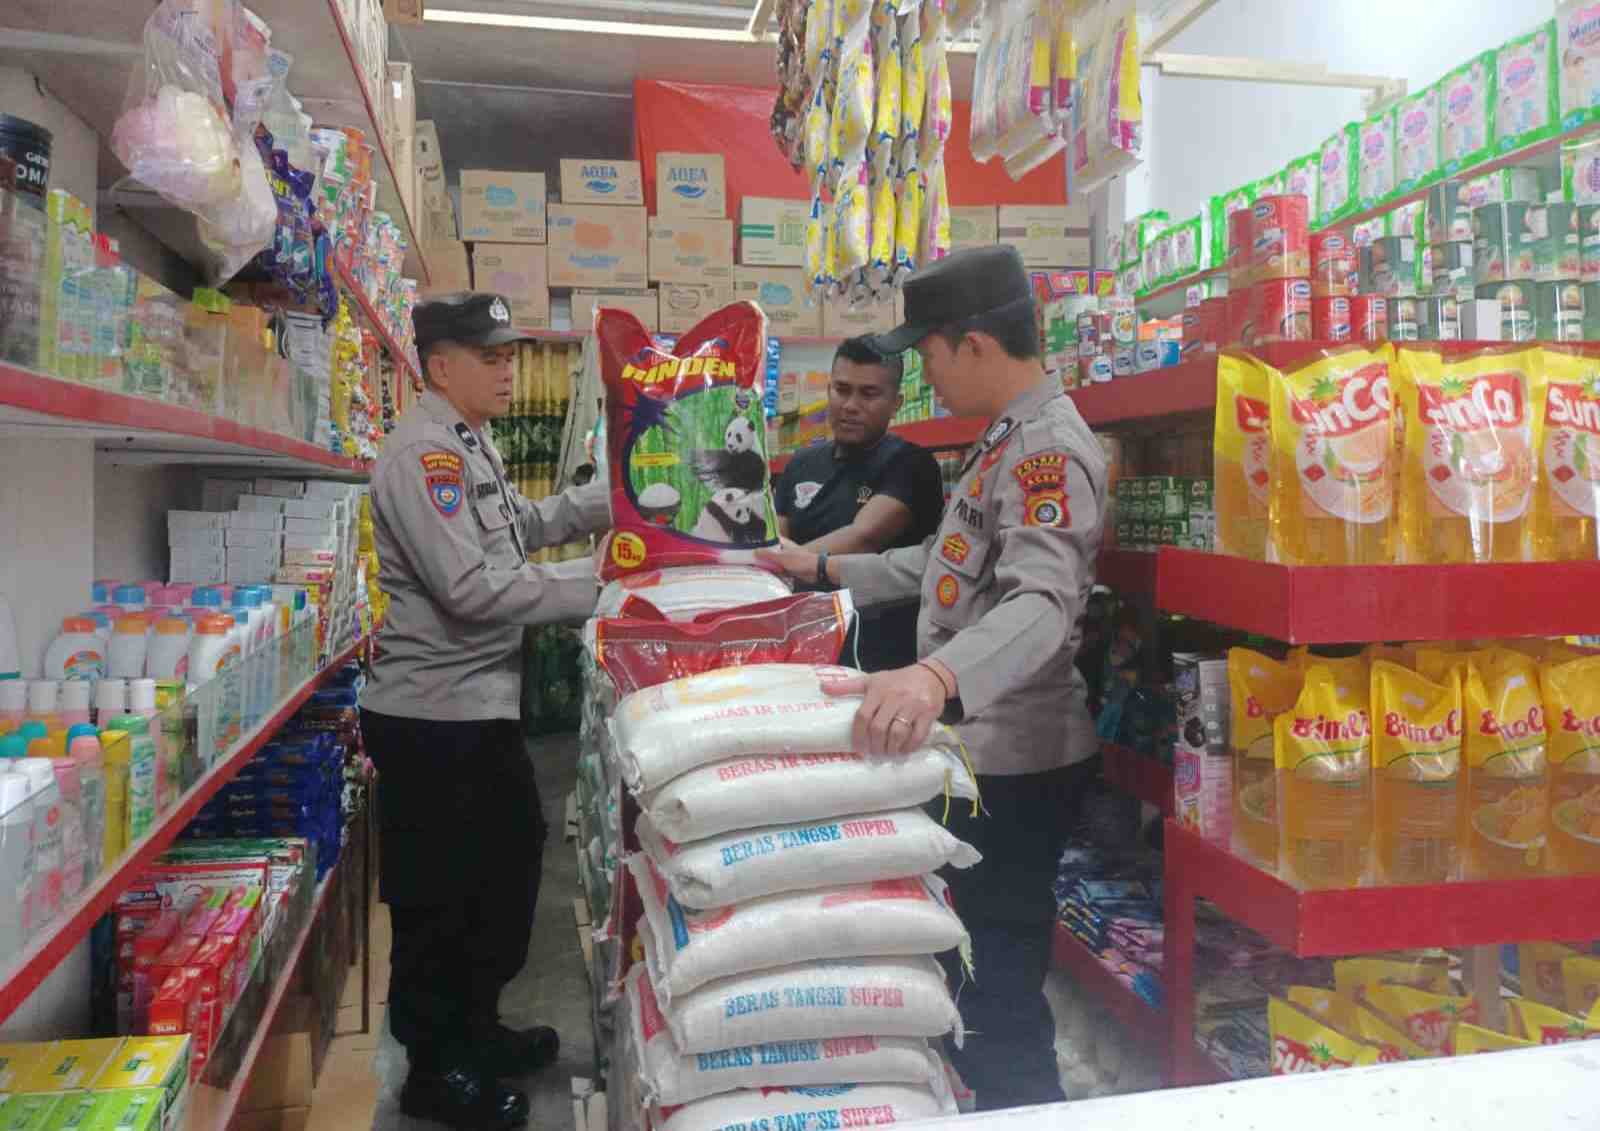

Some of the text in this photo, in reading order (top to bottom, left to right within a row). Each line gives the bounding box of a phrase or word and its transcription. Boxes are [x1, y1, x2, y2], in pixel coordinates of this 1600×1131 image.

[616, 542, 632, 560] 15
[718, 757, 776, 781] BERAS
[720, 819, 897, 866] BERAS TANGSE SUPER
[725, 984, 905, 1018] BERAS TANGSE SUPER
[697, 1046, 753, 1072] BERAS
[759, 1036, 820, 1065] TANGSE
[842, 1105, 897, 1127] SUPER
